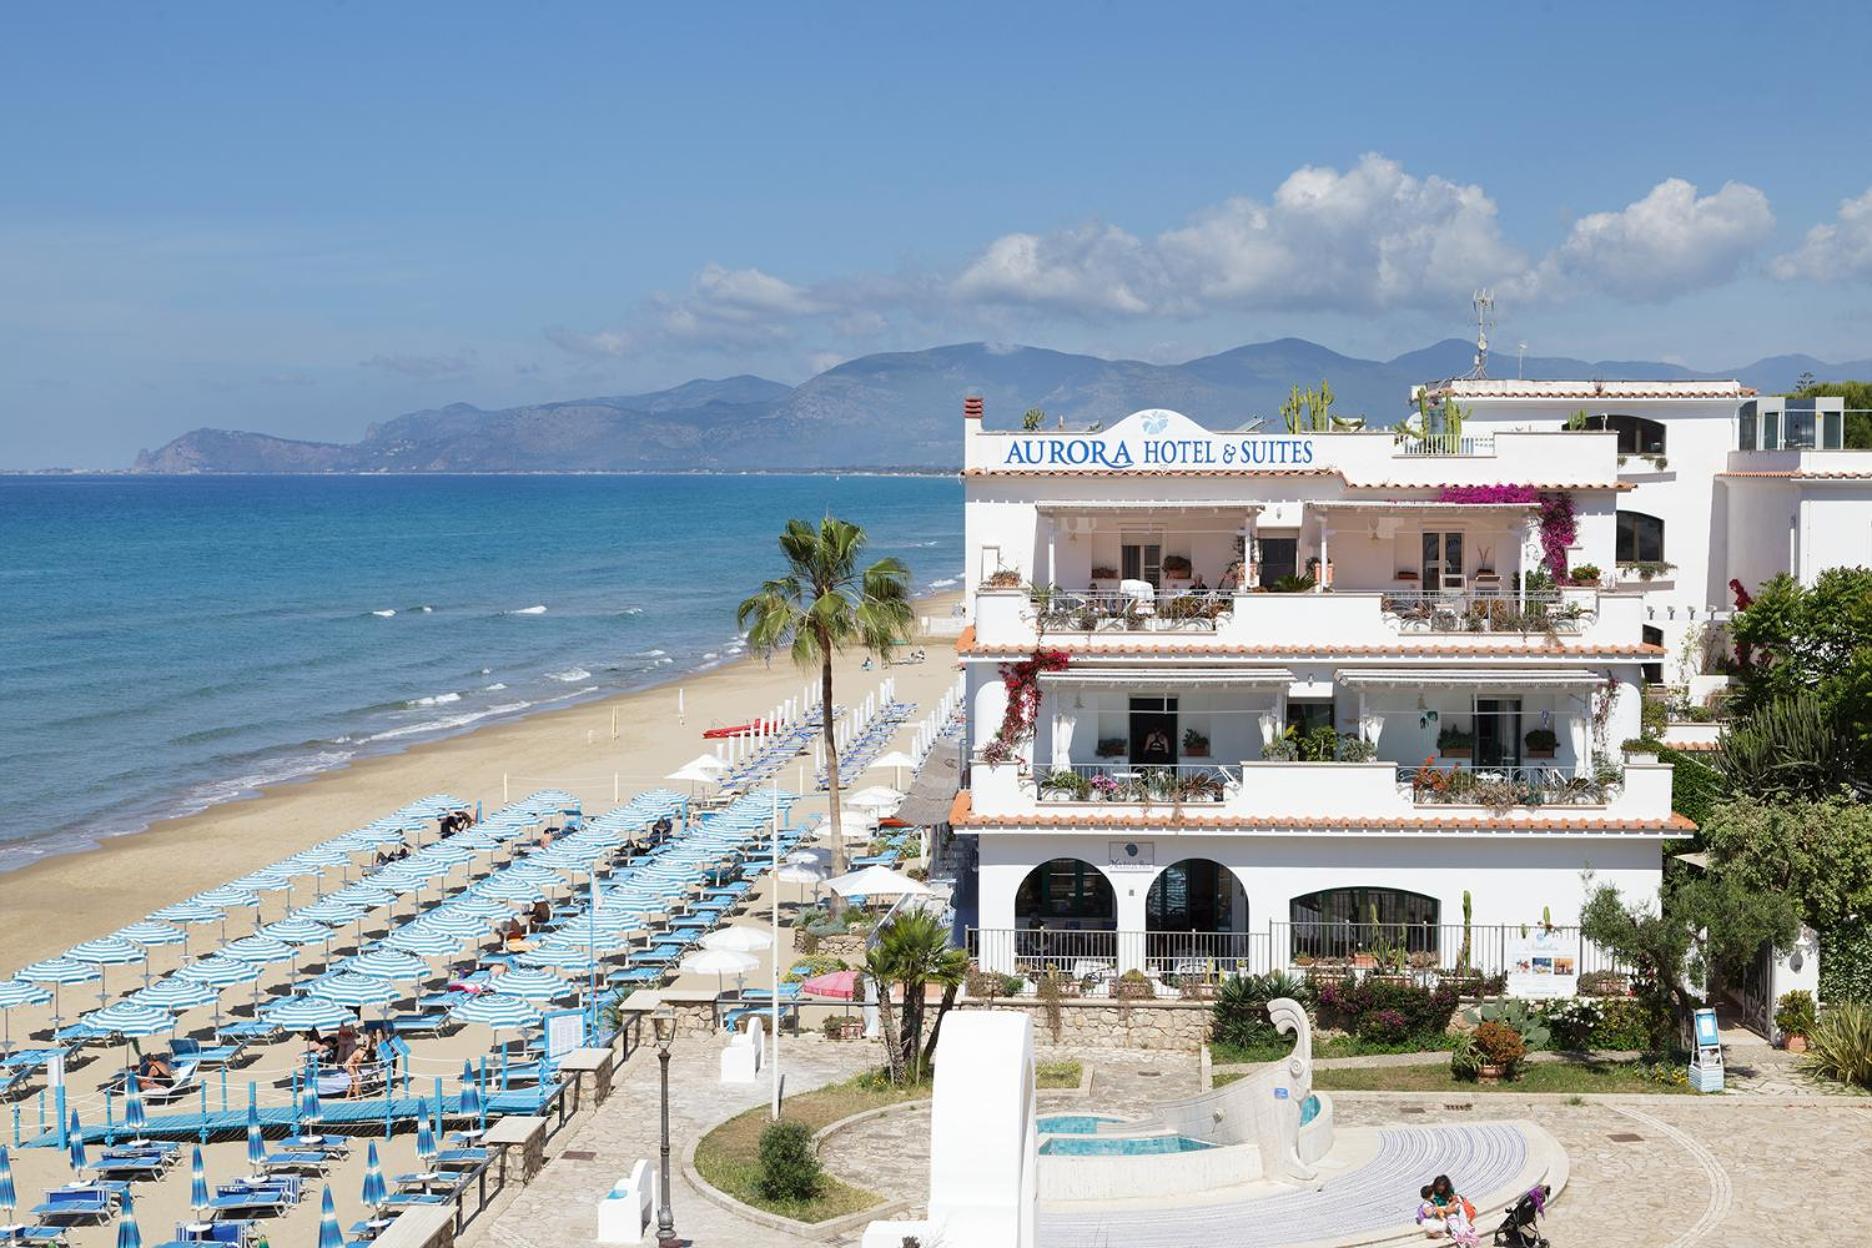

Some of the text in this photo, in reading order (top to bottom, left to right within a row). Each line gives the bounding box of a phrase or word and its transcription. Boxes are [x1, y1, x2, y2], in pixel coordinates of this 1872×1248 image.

[1004, 440, 1312, 468] AURORA HOTEL & SUITES
